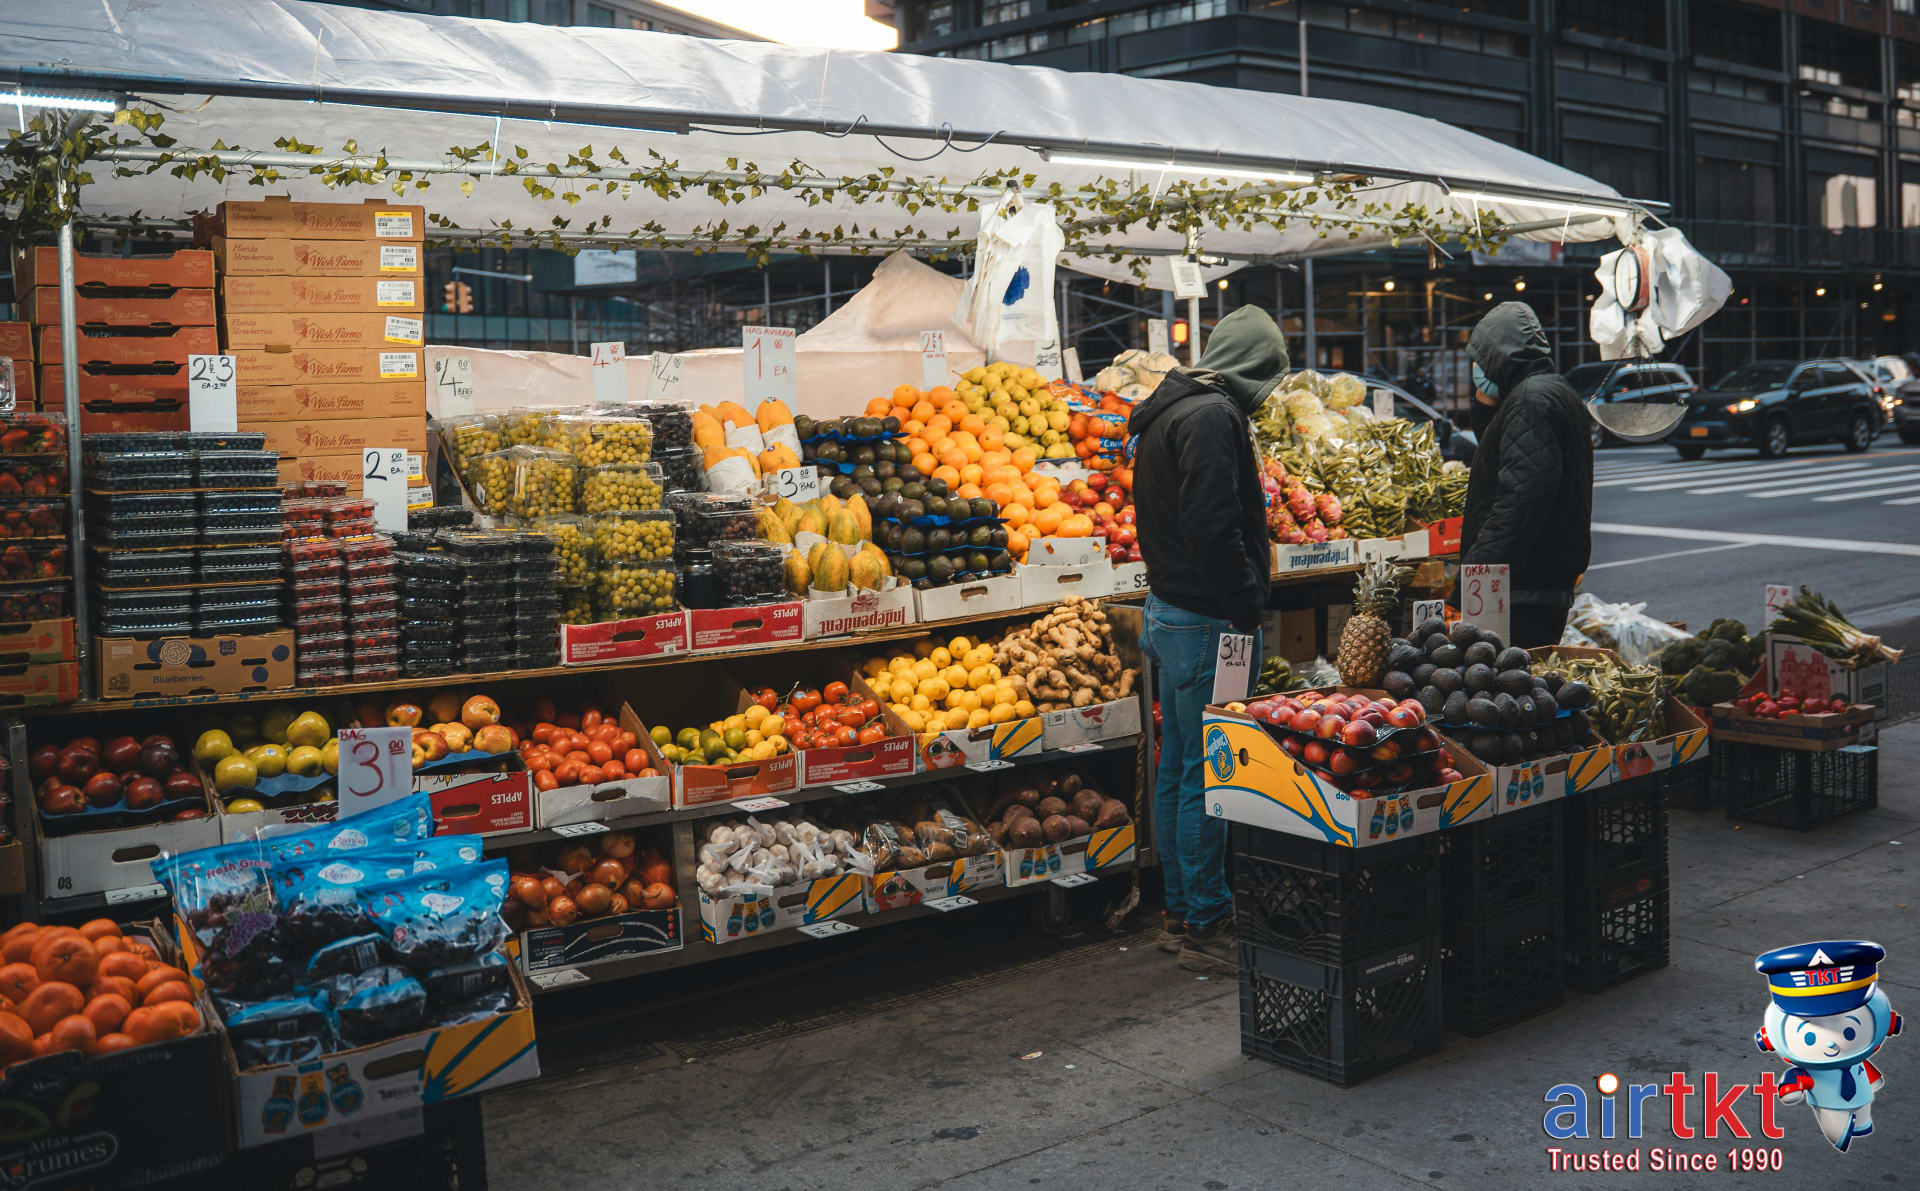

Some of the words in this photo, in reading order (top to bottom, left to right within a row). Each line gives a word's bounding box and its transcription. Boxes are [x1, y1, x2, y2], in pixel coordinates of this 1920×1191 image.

[593, 346, 609, 368] 4
[752, 338, 762, 380] 1
[191, 357, 210, 381] 2
[216, 356, 233, 382] 3
[365, 450, 388, 481] 2
[340, 470, 363, 481] Farm
[781, 470, 798, 498] 3
[1465, 564, 1490, 577] OKRA
[1467, 579, 1483, 616] 3
[773, 607, 798, 619] APPLES
[819, 606, 906, 635] Independent
[656, 617, 682, 630] APPLES
[1220, 635, 1233, 660] 3
[1240, 635, 1246, 660] 1
[153, 674, 204, 684] Blueberries
[339, 729, 366, 741] BAG
[883, 741, 909, 753] APPLES
[348, 741, 383, 796] 3
[769, 757, 794, 772] APPLES
[491, 791, 523, 805] APPLES
